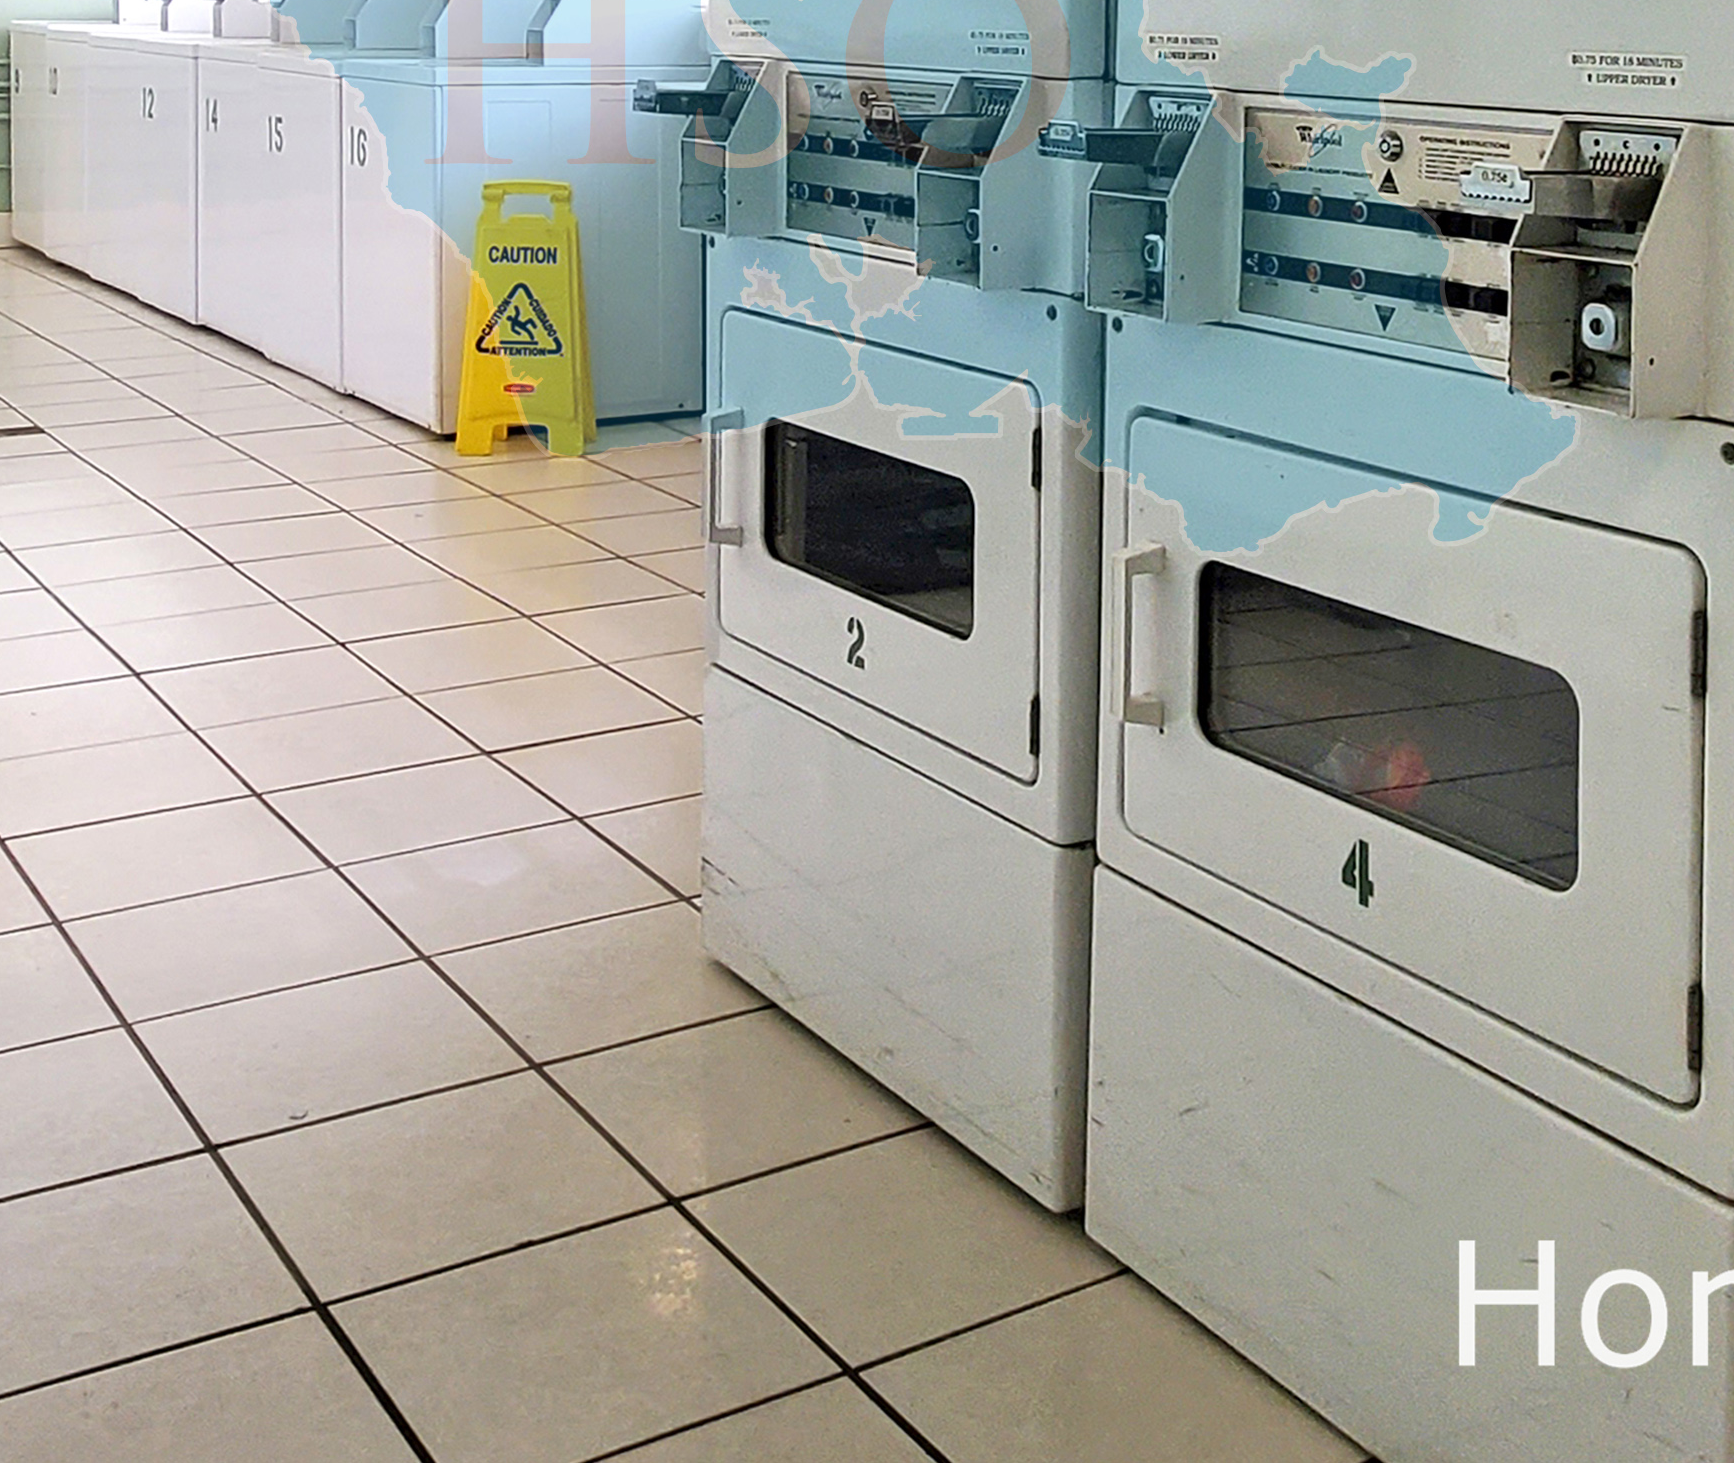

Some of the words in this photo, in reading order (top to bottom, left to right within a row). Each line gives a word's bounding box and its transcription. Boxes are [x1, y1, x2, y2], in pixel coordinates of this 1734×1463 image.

[1596, 73, 1628, 84] UPPER
[1631, 75, 1667, 86] DRYER
[1599, 55, 1620, 66] FOR
[1636, 57, 1683, 69] MINUTES
[142, 87, 154, 119] 12
[205, 98, 217, 132] 14
[269, 116, 283, 152] 15
[350, 126, 367, 167] 16
[488, 246, 558, 264] CAUTION
[481, 298, 512, 337] CAUTION
[529, 299, 557, 337] CUIDADO
[489, 346, 547, 356] ATTENTION
[847, 616, 865, 670] 2
[1342, 838, 1374, 908] 4
